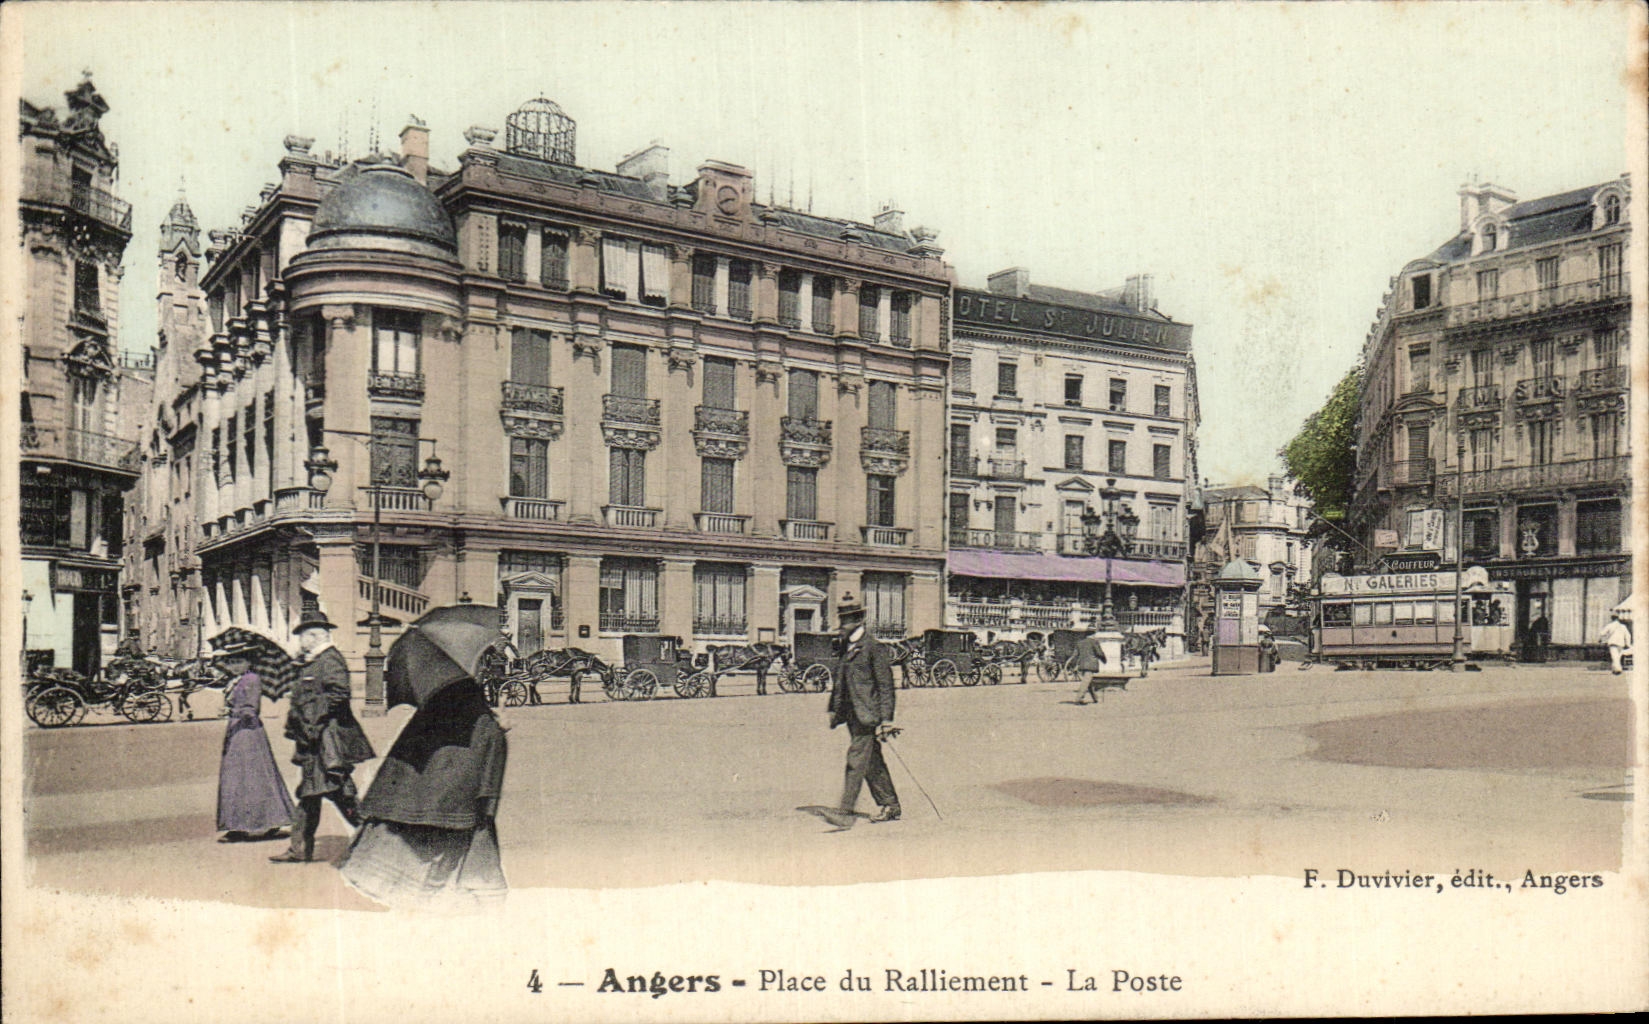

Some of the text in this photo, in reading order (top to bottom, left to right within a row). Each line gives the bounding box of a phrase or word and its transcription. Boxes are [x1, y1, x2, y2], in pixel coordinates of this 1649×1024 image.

[958, 295, 1020, 323] OTEL
[1085, 313, 1170, 345] JULIEN
[1390, 560, 1435, 571] COIFFEUR
[1366, 574, 1438, 590] GALERIES
